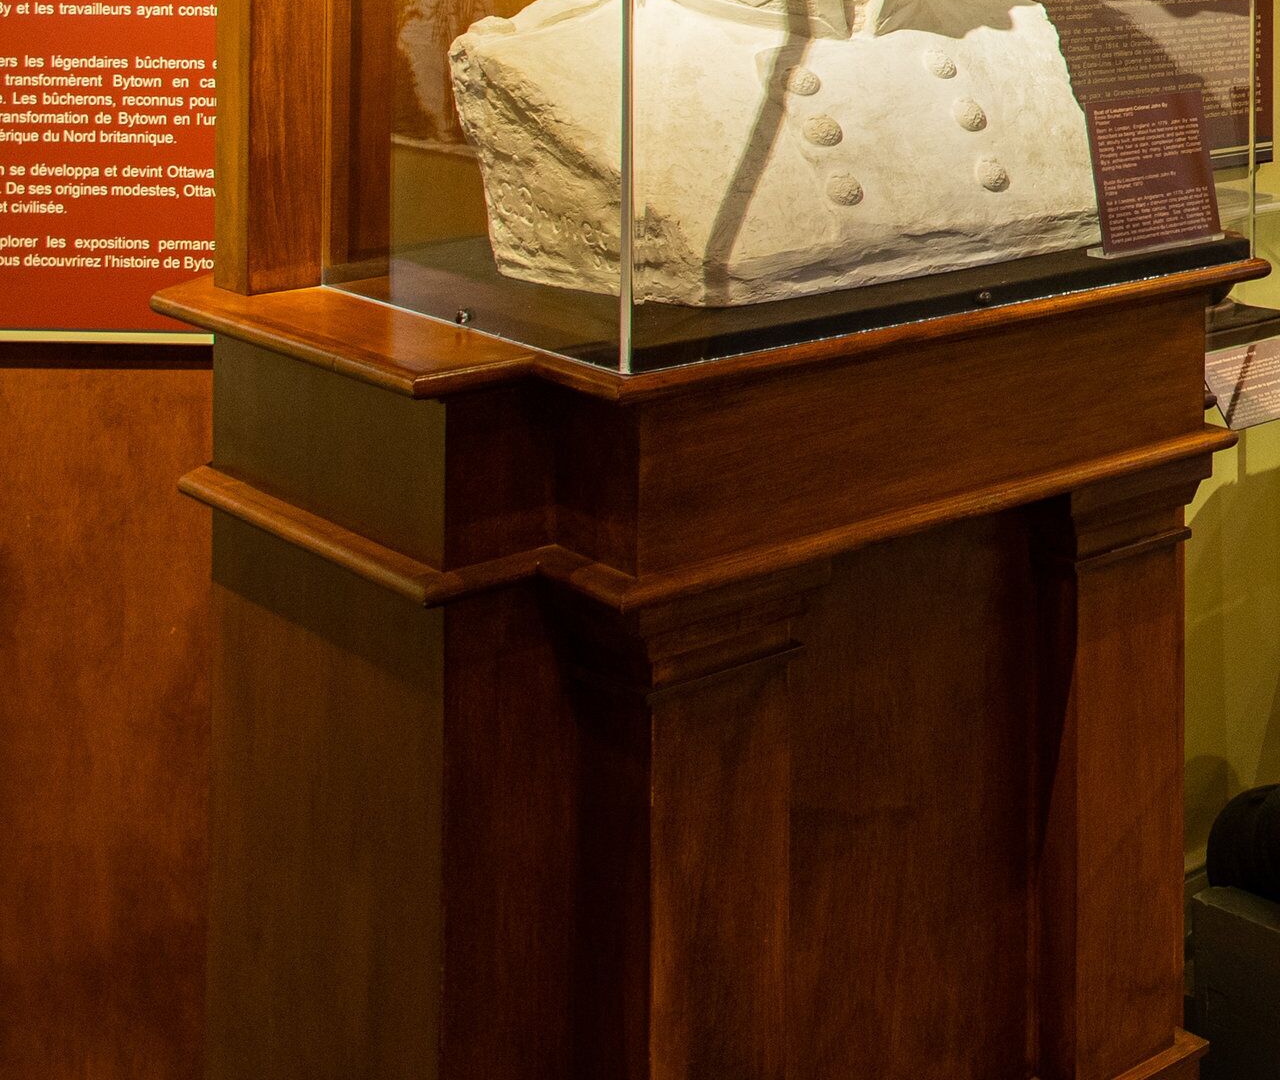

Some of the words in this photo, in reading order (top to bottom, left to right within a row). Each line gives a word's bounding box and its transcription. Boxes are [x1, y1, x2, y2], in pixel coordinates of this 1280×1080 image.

[34, 2, 54, 14] les
[59, 2, 131, 15] travailleurs
[136, 3, 173, 18] ayant
[25, 54, 44, 67] les
[51, 55, 128, 71] légendaires
[135, 56, 205, 69] bûcherons
[4, 73, 103, 86] transformèrent
[113, 74, 162, 90] Bytown
[12, 92, 37, 104] Les
[42, 92, 116, 107] bûcherons,
[122, 96, 184, 106] reconnus
[118, 111, 167, 128] Bytown
[63, 129, 96, 143] Nord
[100, 130, 177, 146] britannique.
[30, 163, 99, 179] développa
[122, 165, 163, 177] devint
[167, 165, 214, 179] Ottawa
[6, 181, 25, 194] De
[55, 183, 108, 198] origines
[111, 183, 179, 198] modestes,
[11, 200, 67, 213] civilisée.
[46, 235, 66, 248] les
[74, 236, 150, 252] expositions
[23, 254, 101, 267] découvrirez
[105, 255, 160, 268] l'histoire
